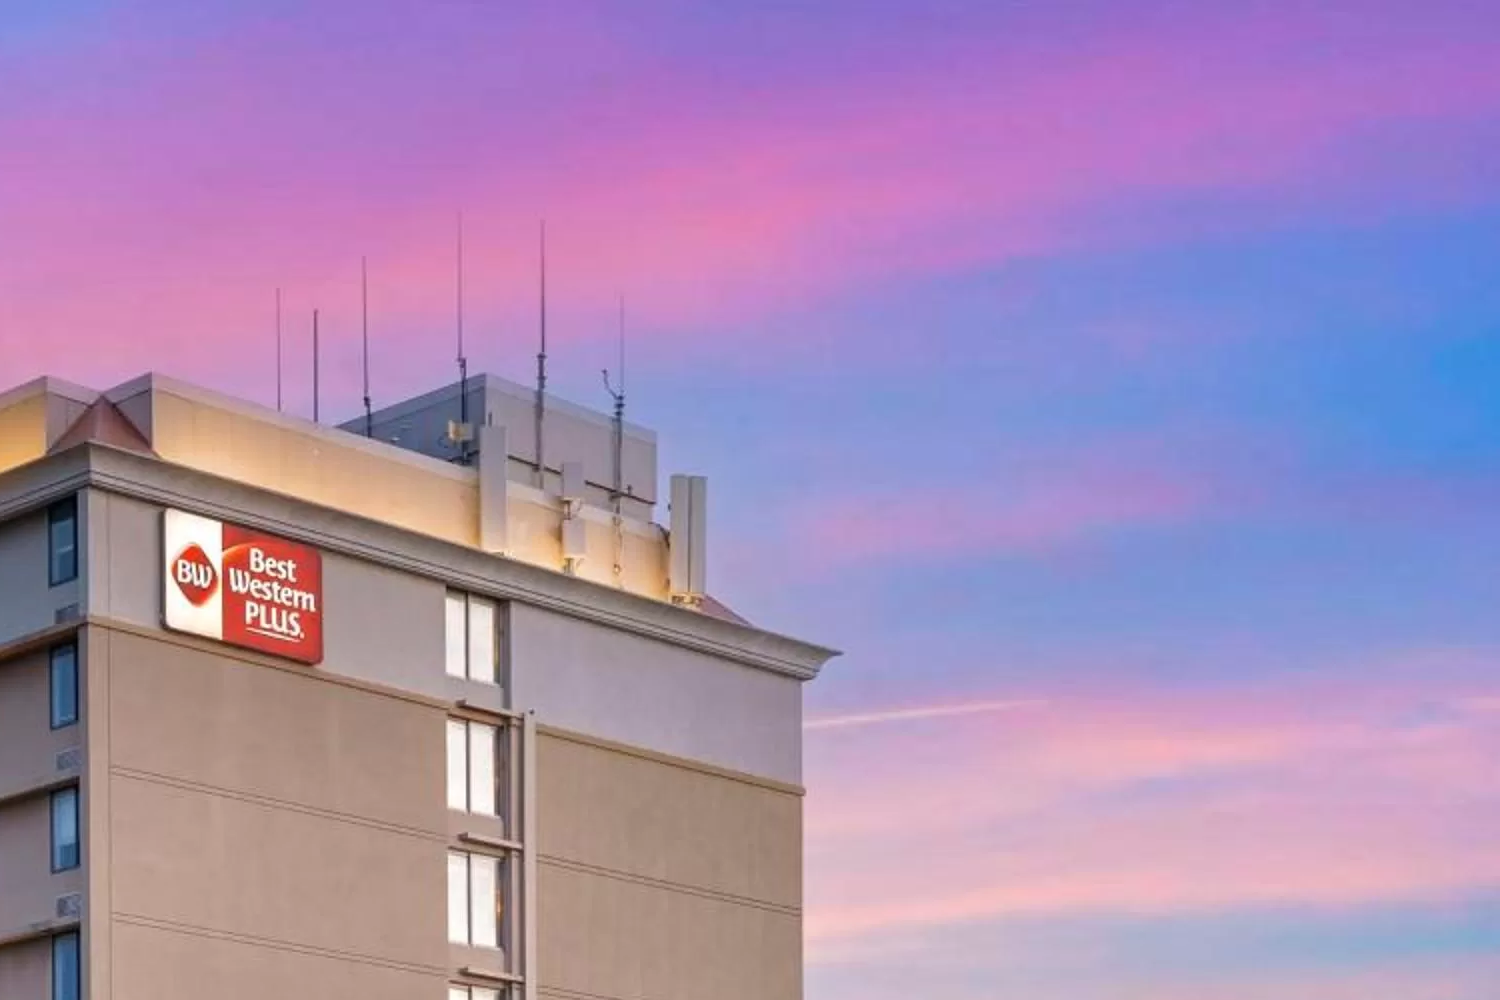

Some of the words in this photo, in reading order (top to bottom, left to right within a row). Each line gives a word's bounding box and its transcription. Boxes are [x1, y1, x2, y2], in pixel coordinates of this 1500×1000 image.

[177, 559, 213, 589] BW
[250, 547, 297, 583] Best
[228, 566, 317, 613] Western
